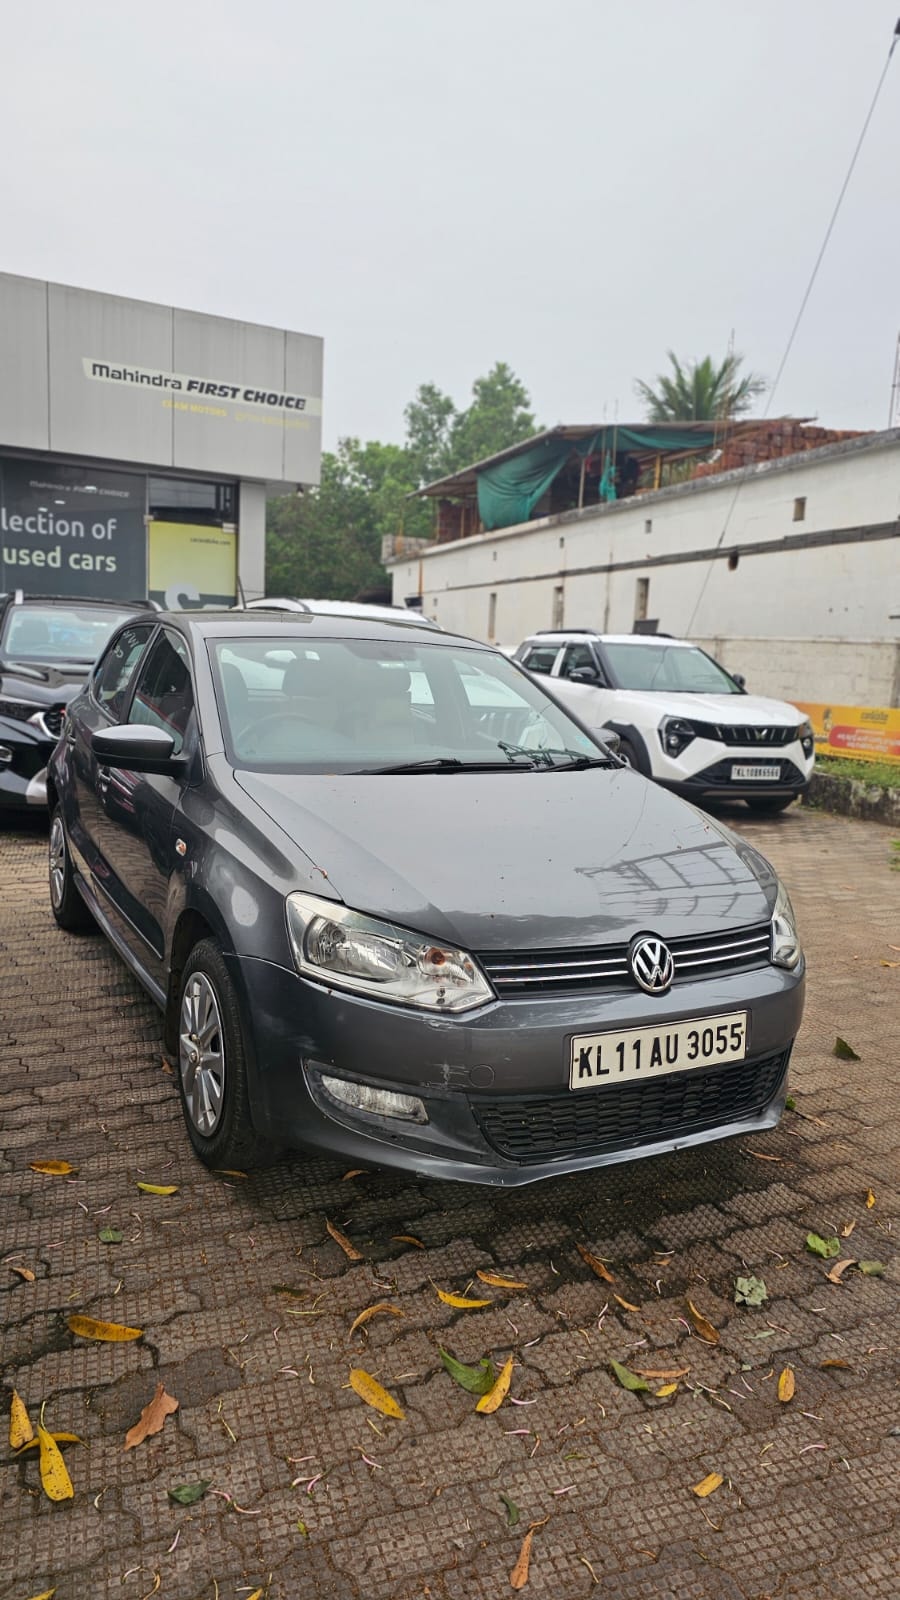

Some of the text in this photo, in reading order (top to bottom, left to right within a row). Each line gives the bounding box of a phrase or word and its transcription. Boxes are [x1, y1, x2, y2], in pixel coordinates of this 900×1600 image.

[92, 363, 306, 410] Mahindra FIRST CHOICE
[1, 508, 117, 540] lection of
[2, 546, 117, 573] used cars
[687, 1022, 743, 1060] 3055
